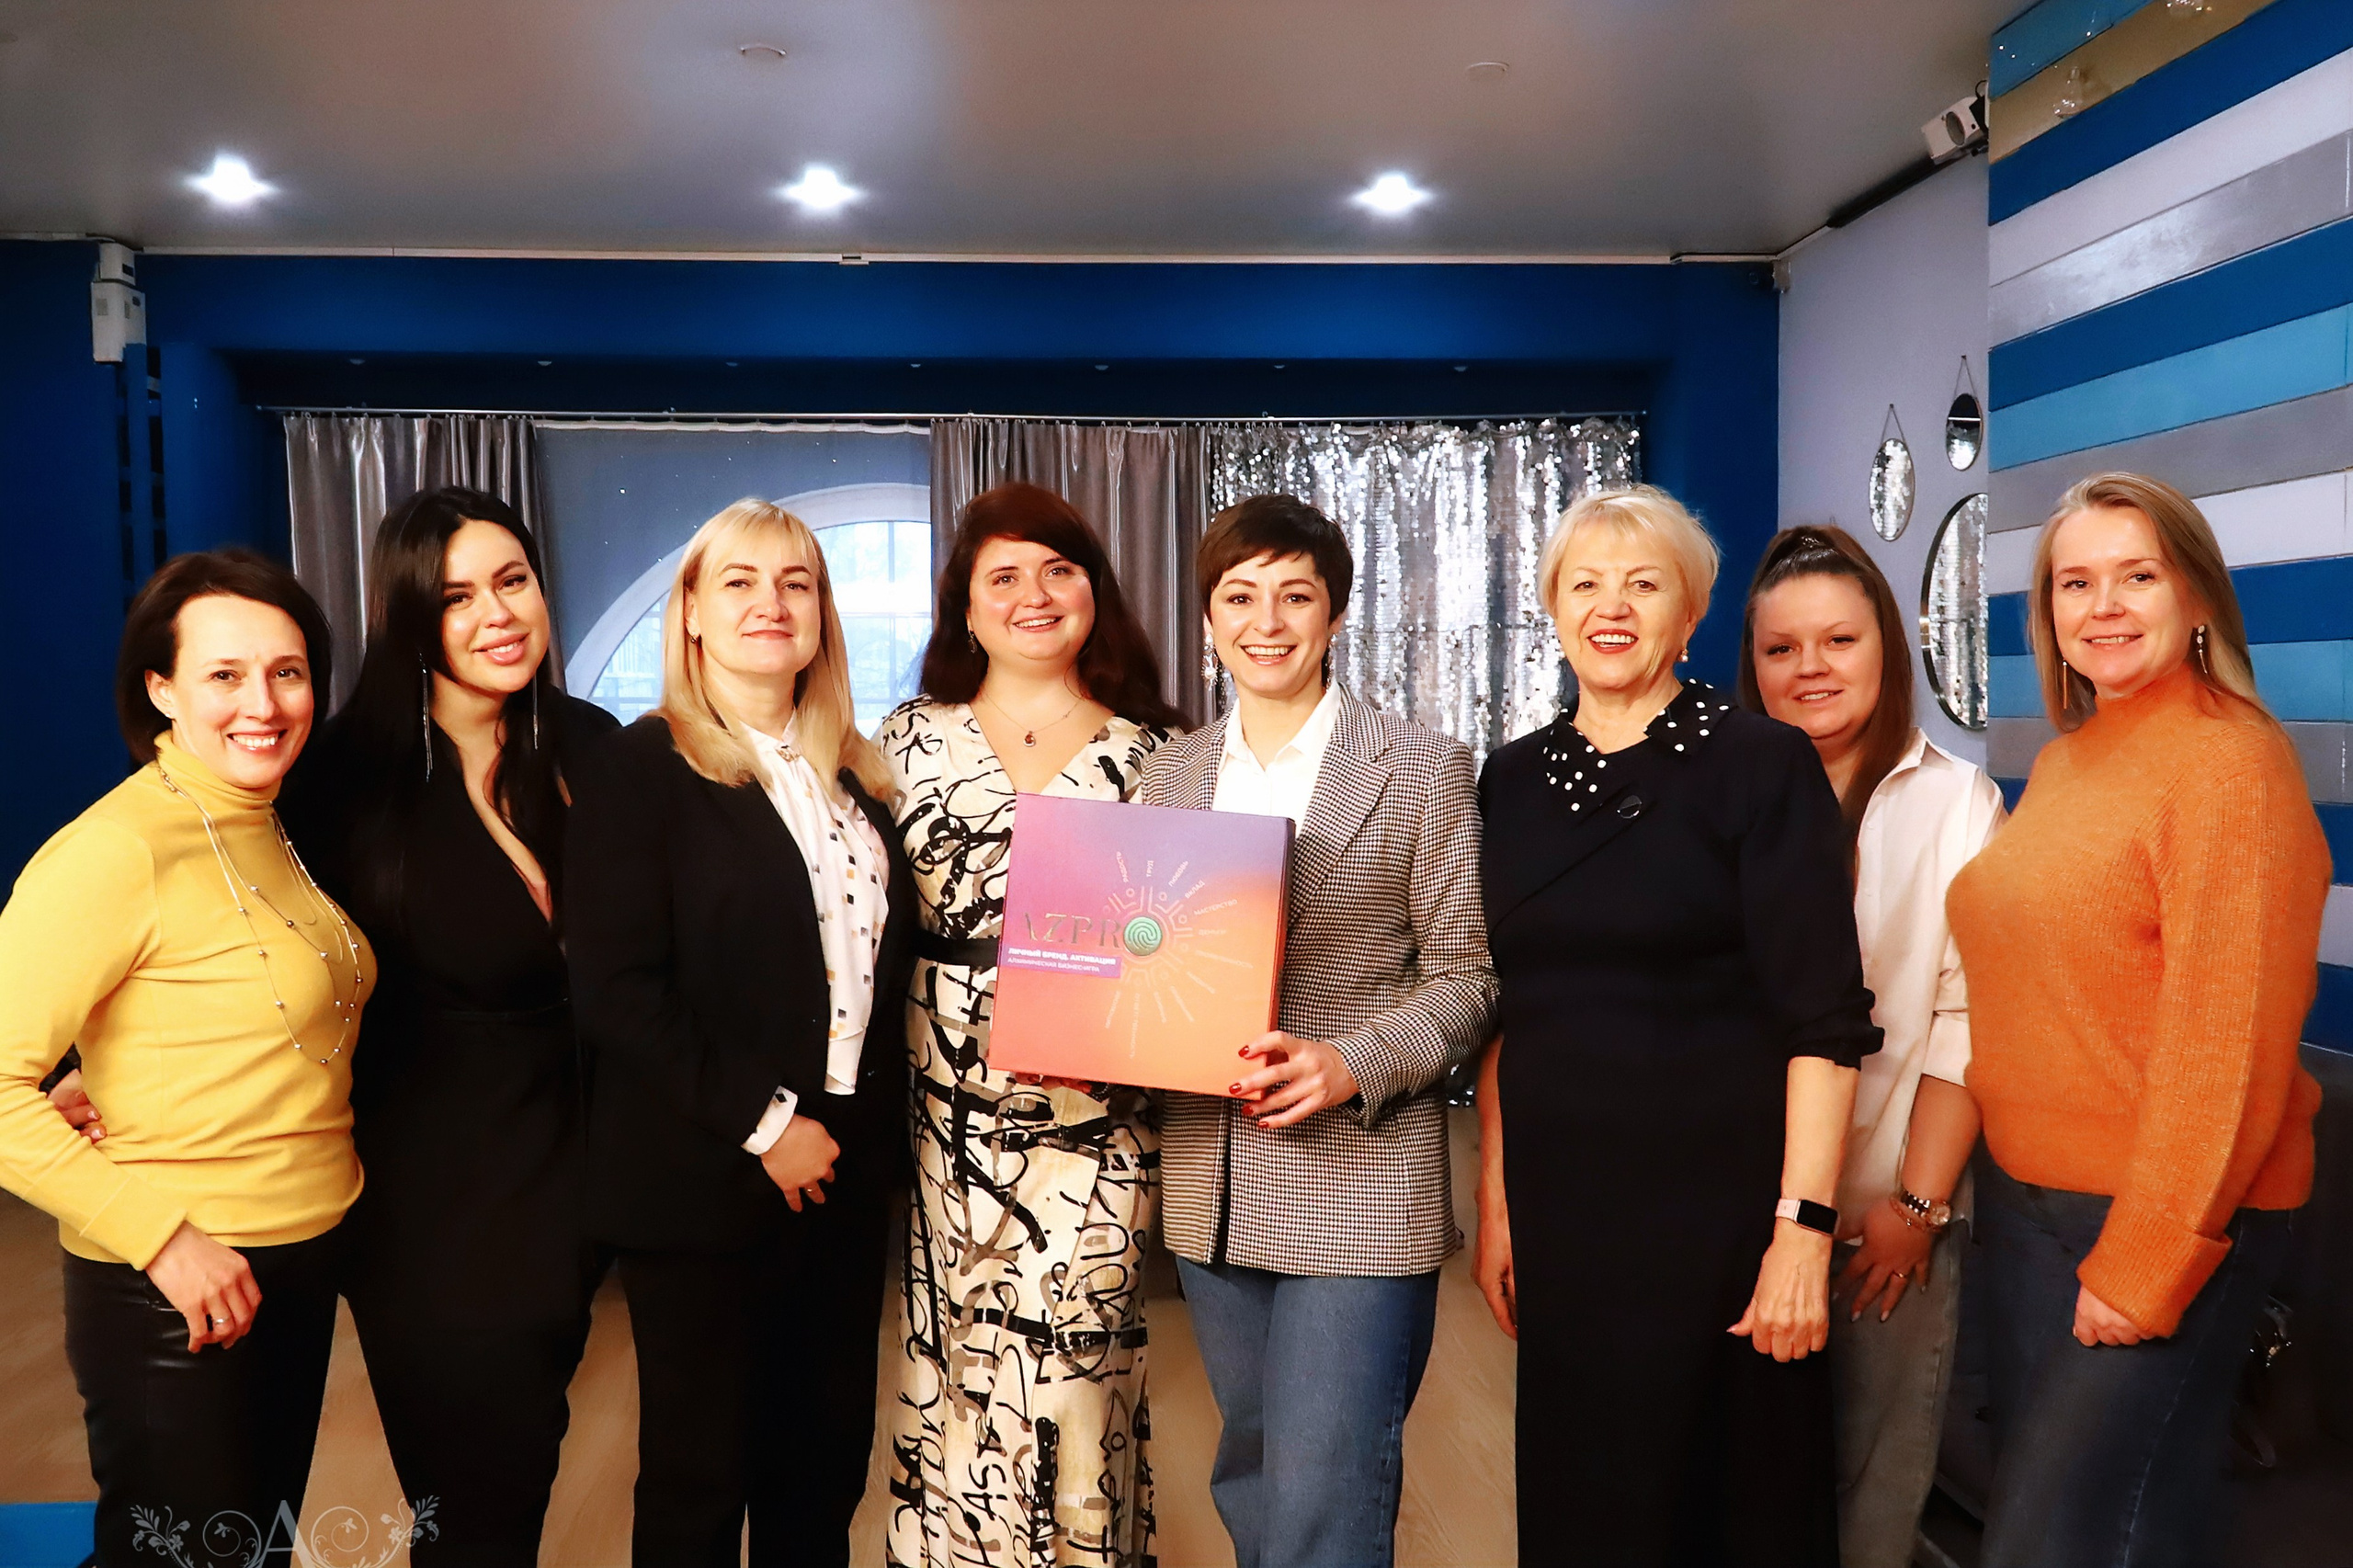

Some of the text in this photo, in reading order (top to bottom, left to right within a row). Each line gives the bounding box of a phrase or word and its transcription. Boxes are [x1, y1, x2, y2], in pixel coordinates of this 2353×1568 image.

[1146, 859, 1154, 878] ТРУД
[1168, 860, 1189, 887] ЛЮБОВЬ
[1185, 879, 1205, 899] ВКЛАД
[1007, 948, 1041, 958] ЛИЧНЫЙ
[1069, 954, 1116, 965] АКТИВАЦИЯ
